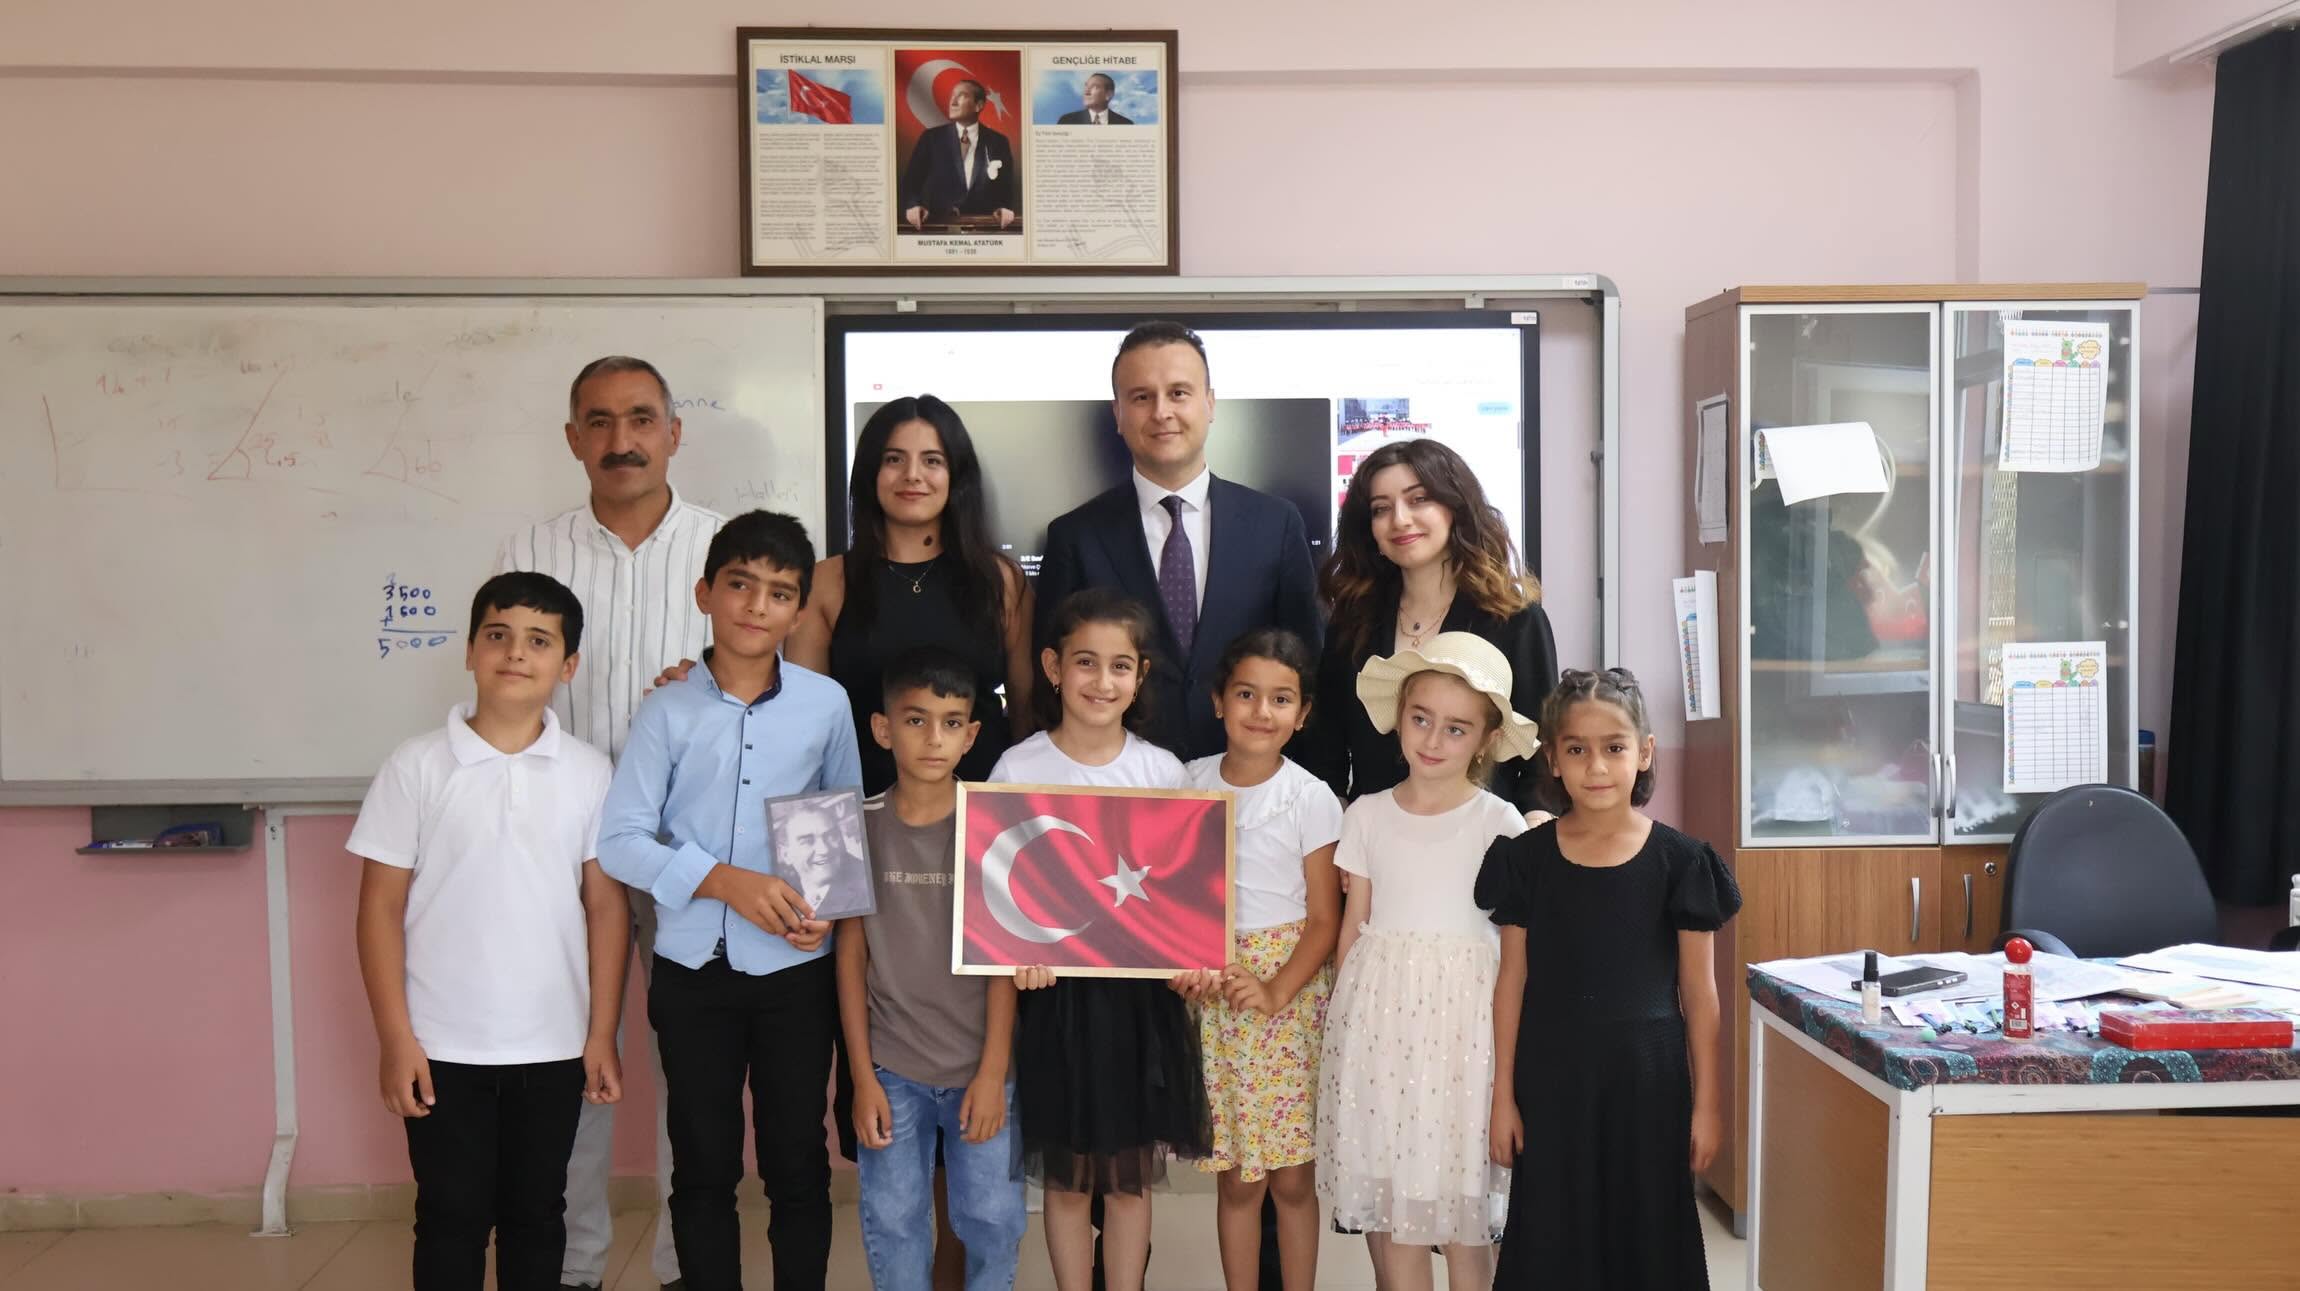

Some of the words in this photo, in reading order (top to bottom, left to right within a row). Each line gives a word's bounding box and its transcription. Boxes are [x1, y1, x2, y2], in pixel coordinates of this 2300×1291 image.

[780, 53, 822, 64] İSTİKLAL
[1052, 55, 1101, 66] GENÇLİĞE
[1103, 55, 1137, 65] HİTABE
[382, 584, 431, 601] 3500
[377, 635, 447, 659] 5000
